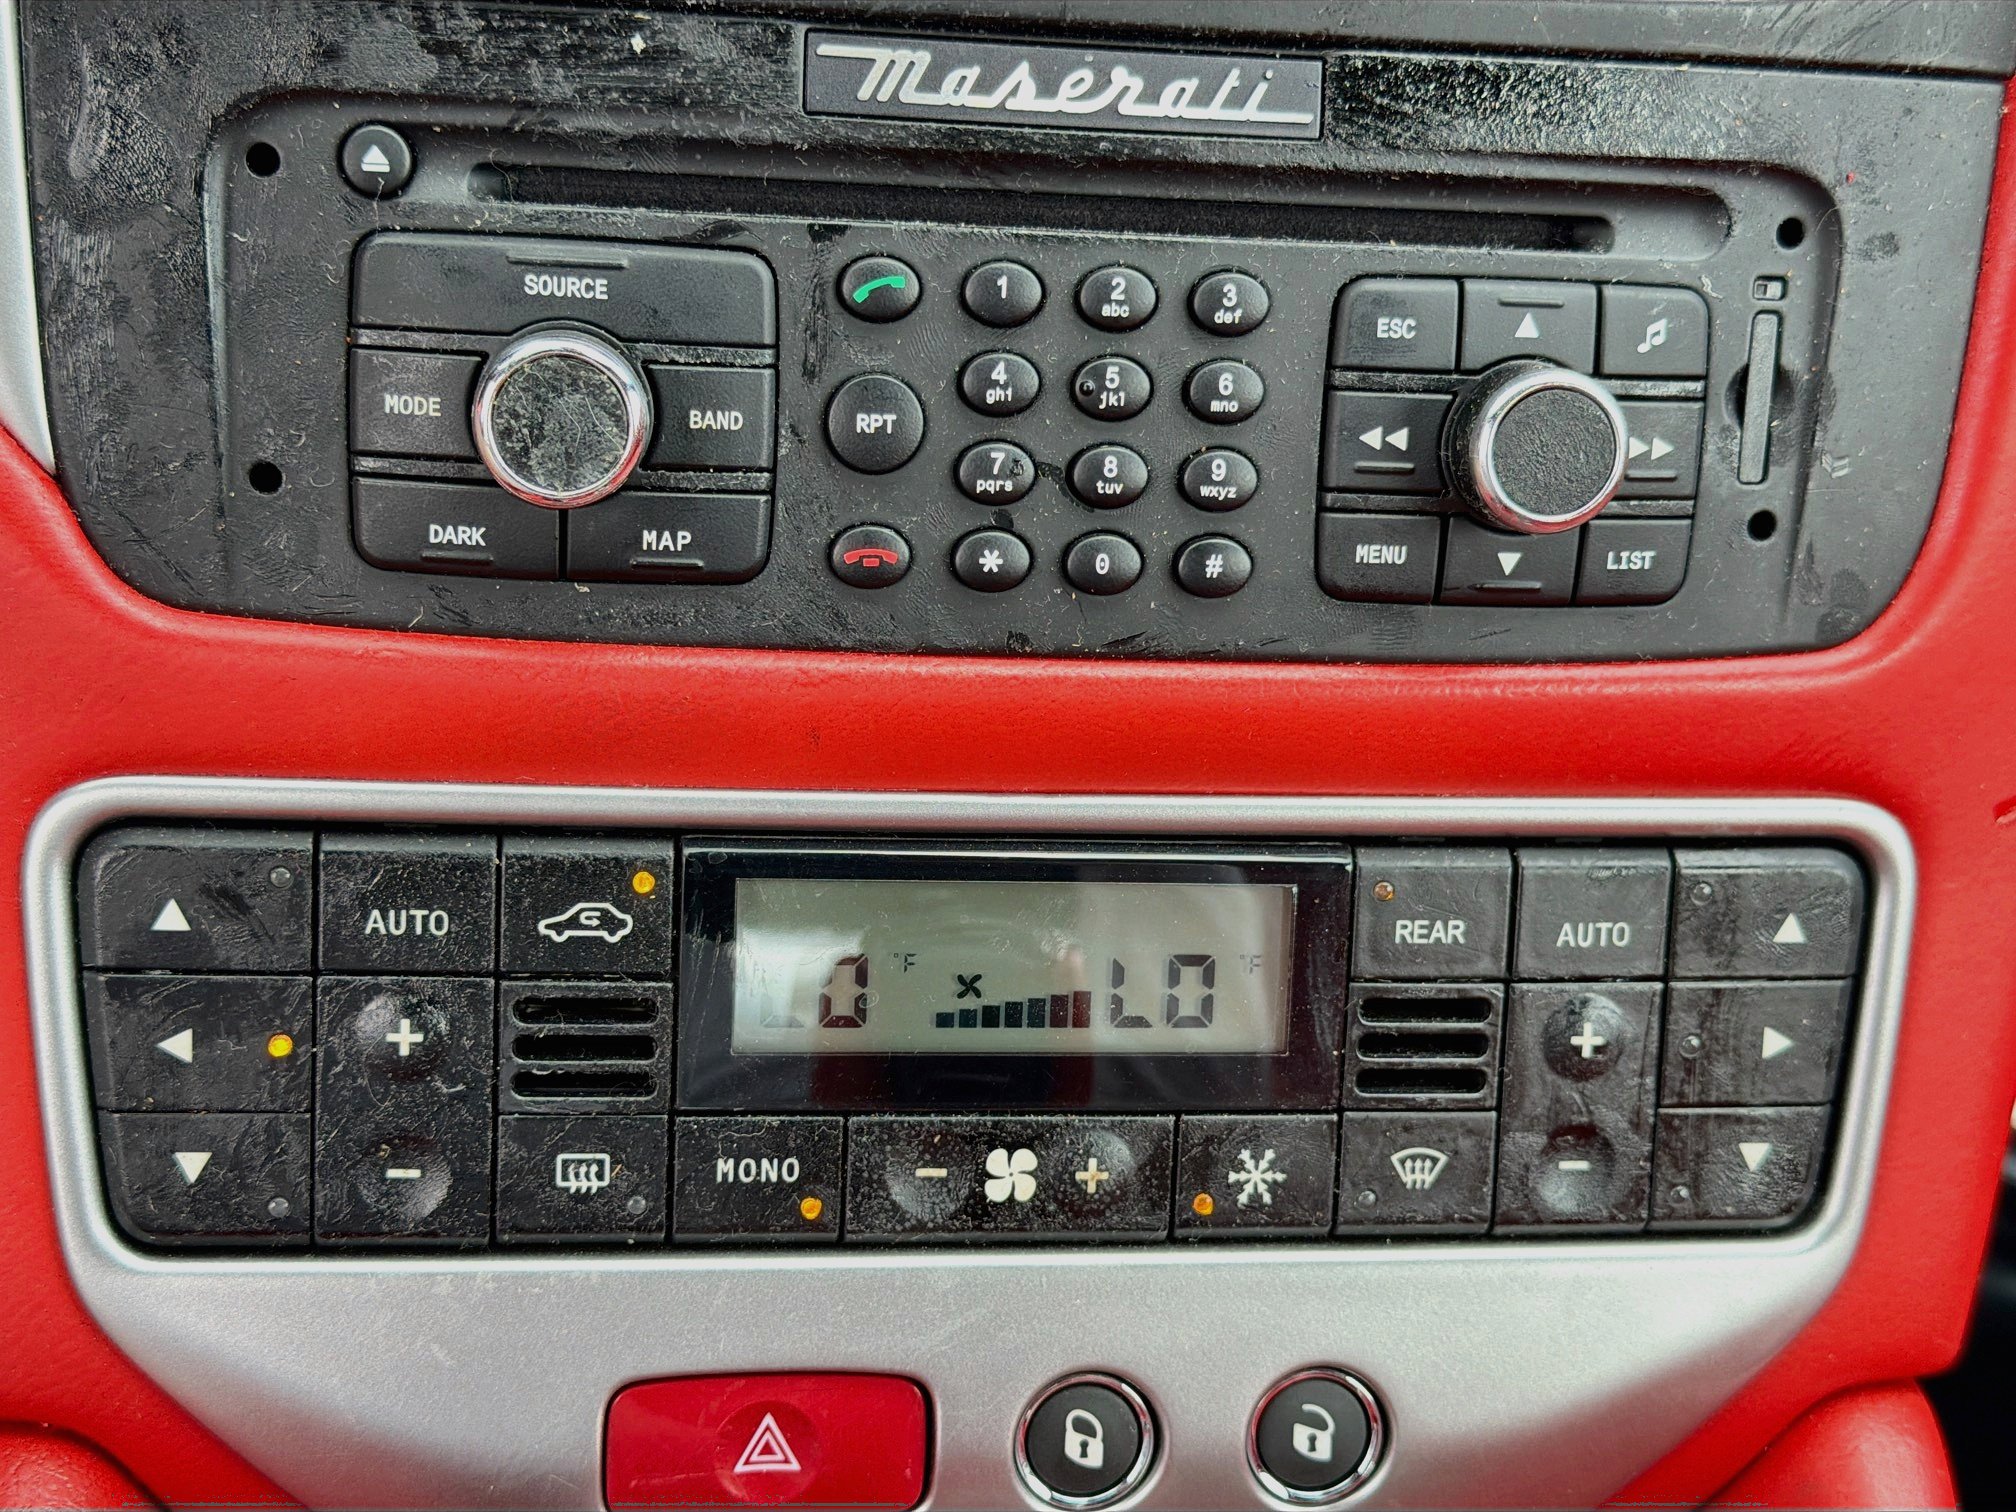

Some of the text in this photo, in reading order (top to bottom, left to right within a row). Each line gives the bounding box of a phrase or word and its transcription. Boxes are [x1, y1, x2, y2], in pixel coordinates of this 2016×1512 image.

[816, 44, 1315, 124] Maserati
[523, 274, 609, 300] SOURCE
[996, 276, 1008, 299] 1
[1111, 277, 1126, 301] 2
[1222, 284, 1238, 308] 3
[1101, 303, 1130, 318] abc
[1214, 307, 1242, 324] def
[1376, 318, 1417, 340] ESC
[990, 361, 1008, 385] 4
[1104, 366, 1120, 390] 5
[1217, 372, 1234, 396] 6
[384, 394, 442, 417] MODE
[985, 387, 1013, 404] ghi
[1099, 391, 1125, 409] jkl
[1210, 399, 1239, 414] mno
[689, 410, 744, 431] BAND
[856, 413, 897, 435] RPT
[990, 452, 1006, 476] 7
[1102, 455, 1118, 479] 8
[1210, 458, 1226, 482] 9
[976, 477, 1014, 494] pqrs
[1096, 480, 1125, 495] tuv
[1199, 484, 1237, 500] wxyz
[428, 524, 487, 547] DARK
[642, 530, 693, 552] MAP
[1095, 553, 1110, 576] 0
[1355, 544, 1408, 565] MENU
[1606, 550, 1656, 571] LIST
[1205, 554, 1225, 579] #
[364, 908, 450, 936] AUTO
[1394, 919, 1467, 945] REAR
[1555, 921, 1631, 949] AUTO
[715, 1156, 801, 1185] MONO
